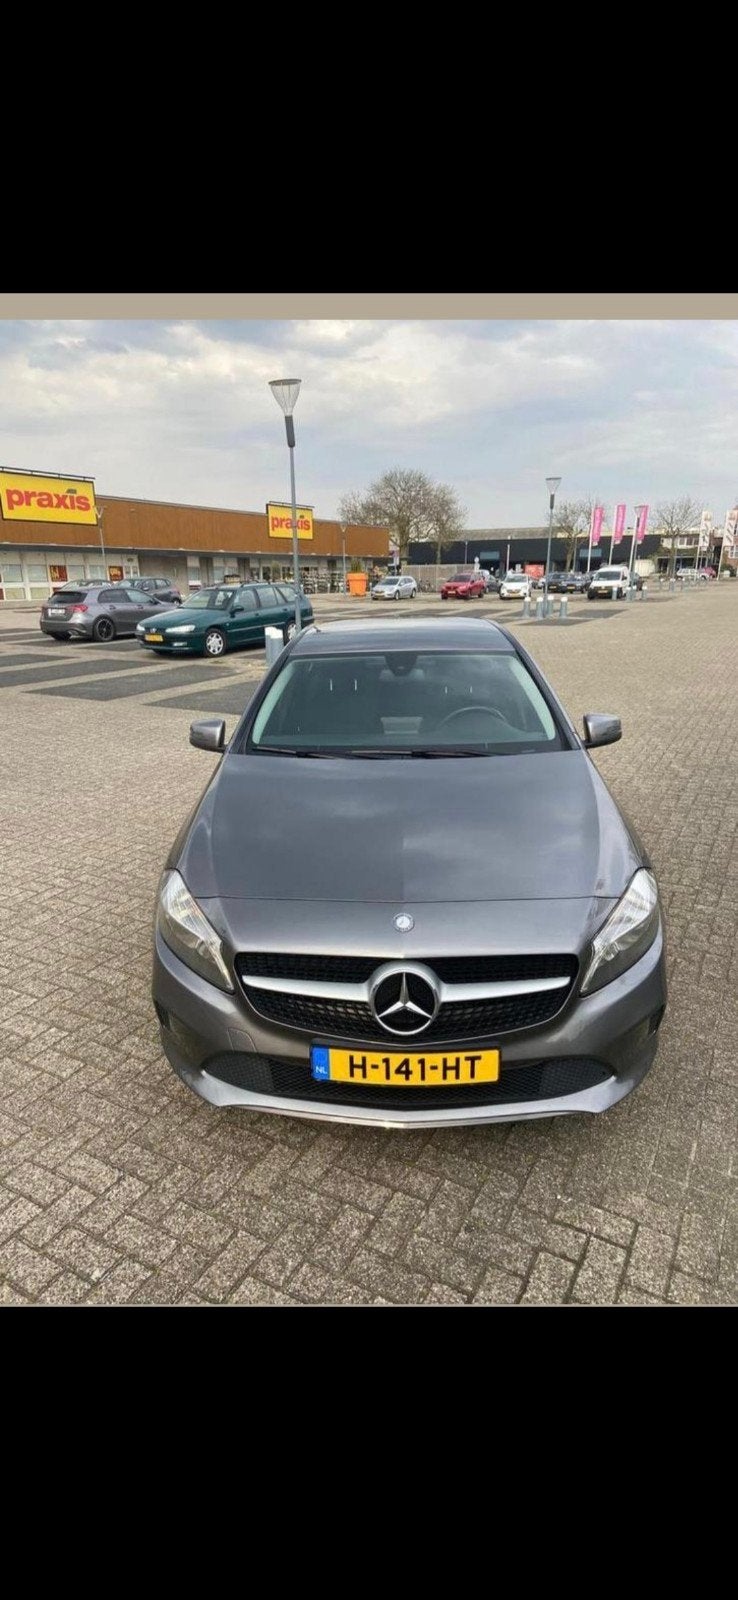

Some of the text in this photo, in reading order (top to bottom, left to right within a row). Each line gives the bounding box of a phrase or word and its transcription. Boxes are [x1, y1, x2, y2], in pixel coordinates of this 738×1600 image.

[6, 489, 91, 512] praxis
[315, 1066, 328, 1075] NL
[349, 1055, 482, 1081] H-141-HT
